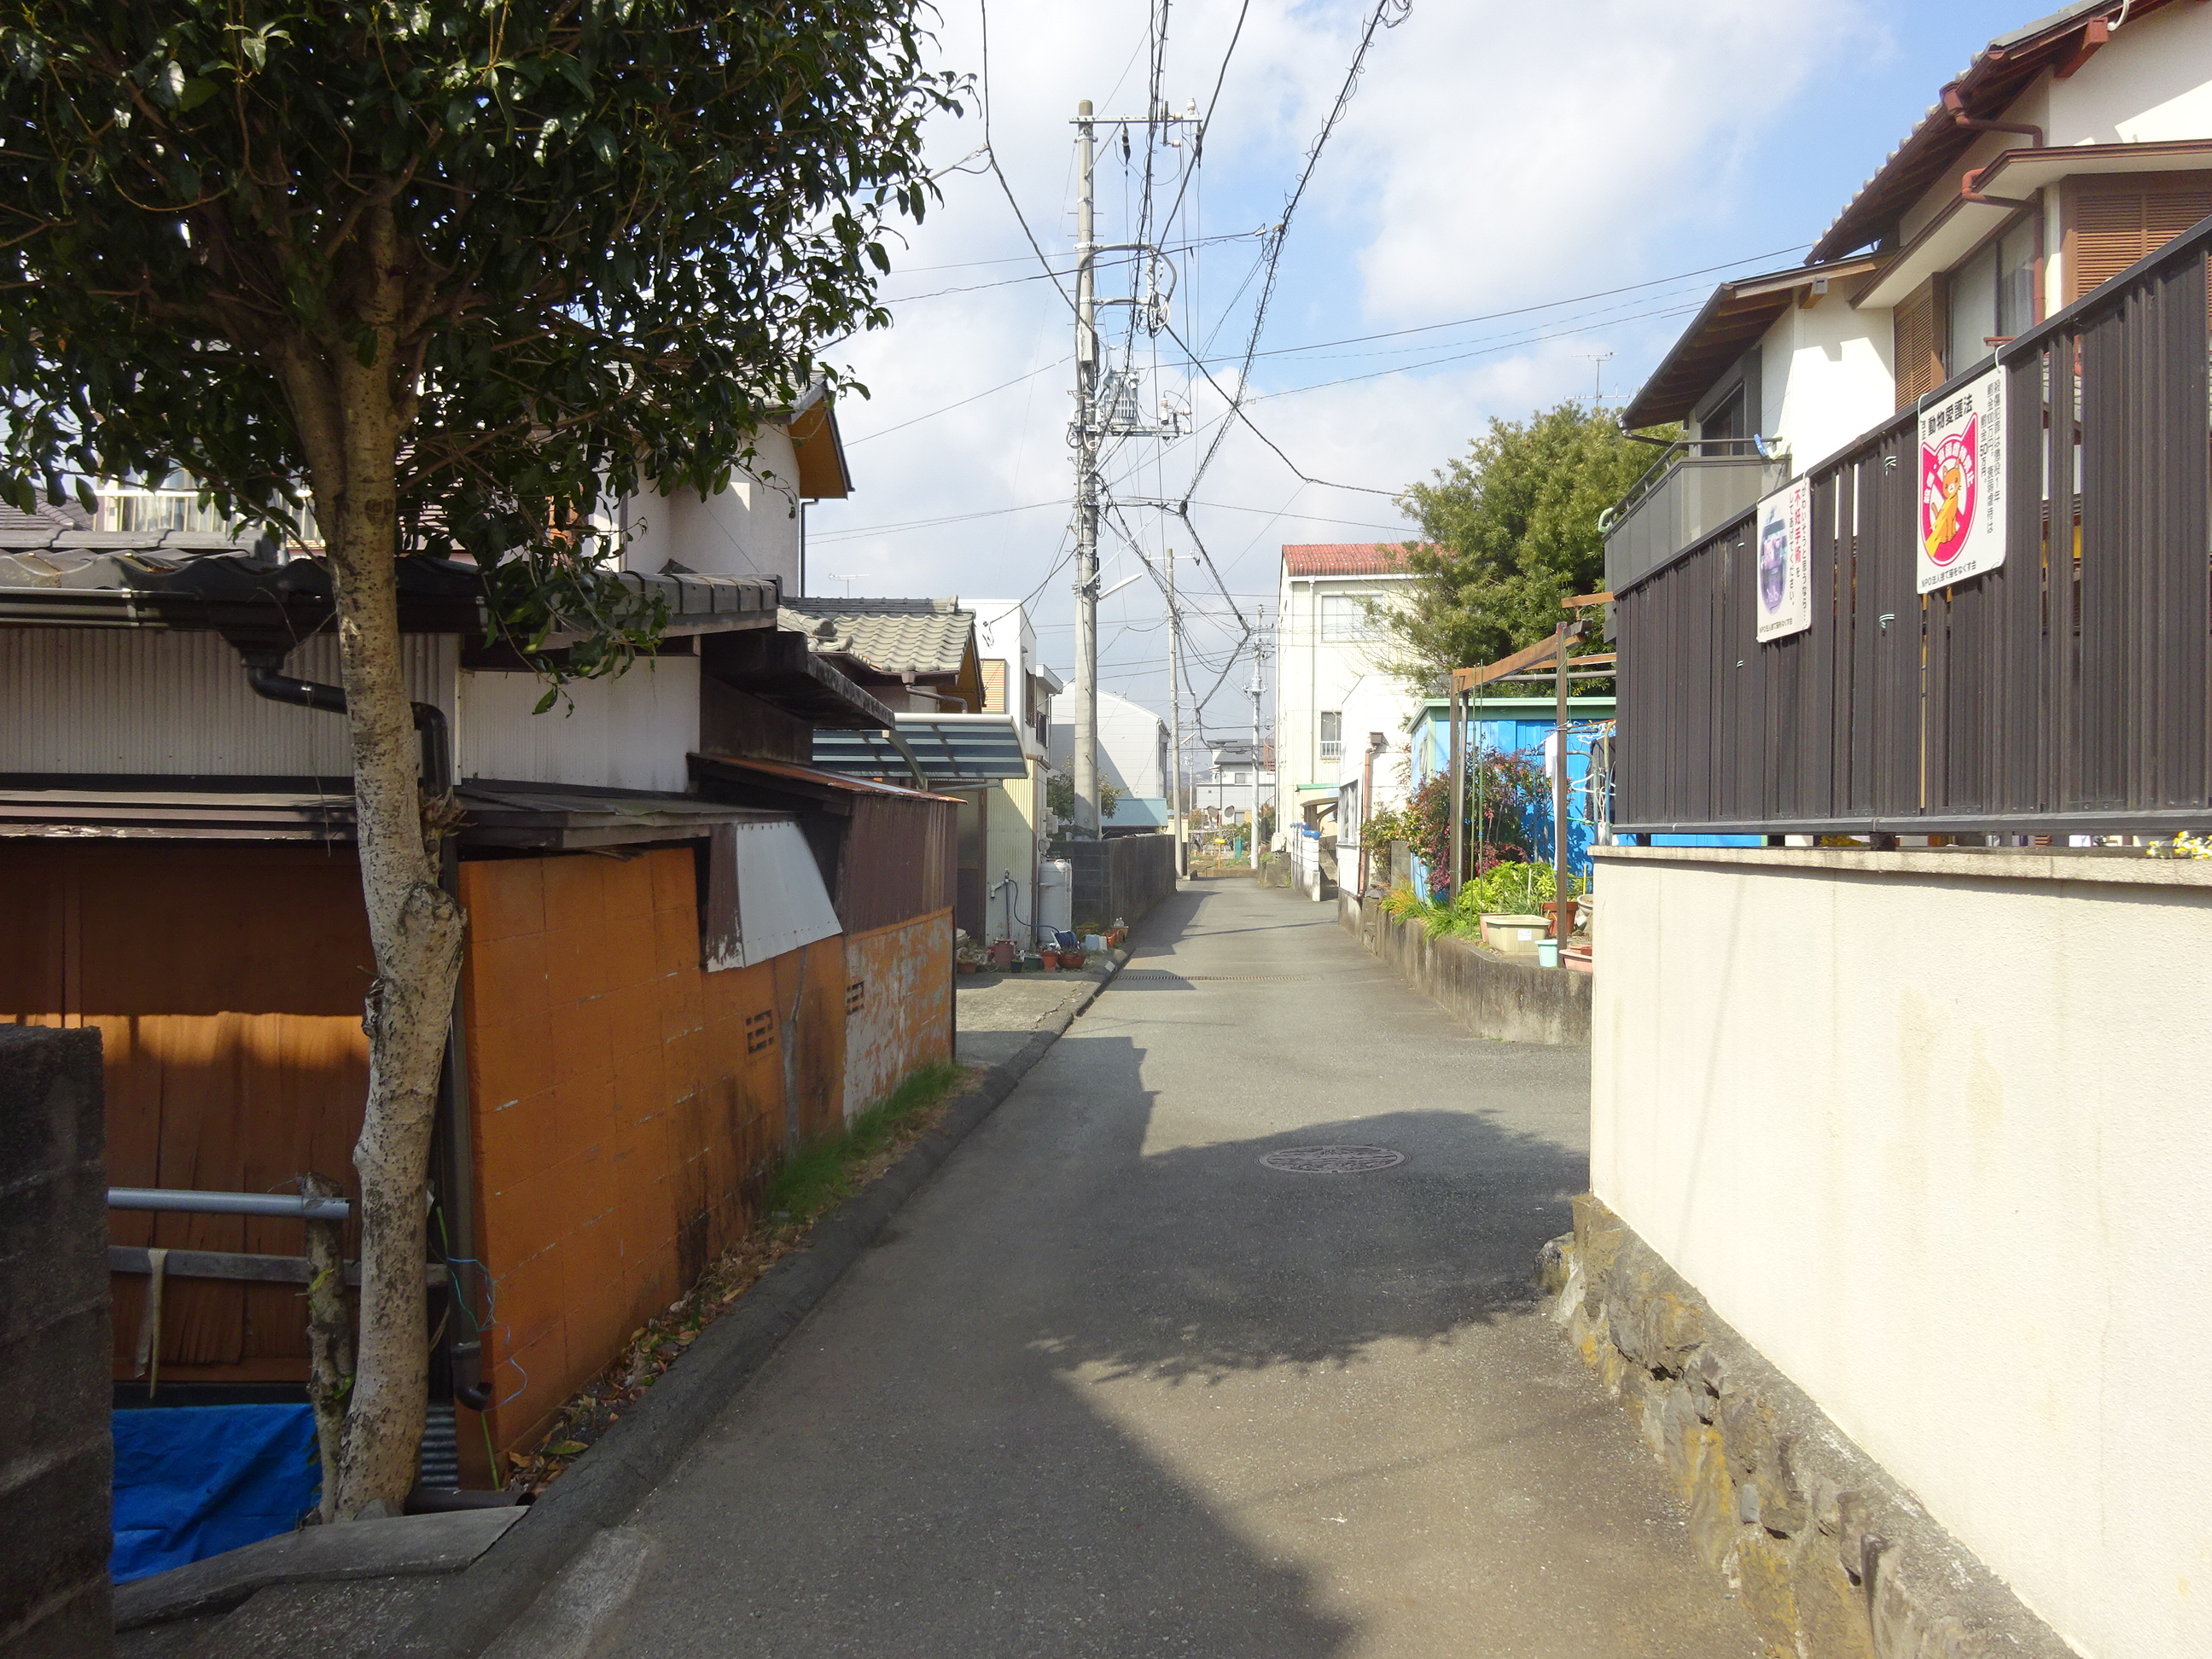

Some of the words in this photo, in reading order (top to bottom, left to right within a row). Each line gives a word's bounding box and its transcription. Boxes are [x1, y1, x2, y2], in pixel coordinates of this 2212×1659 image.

[1928, 394, 1972, 436] 動物愛護法
